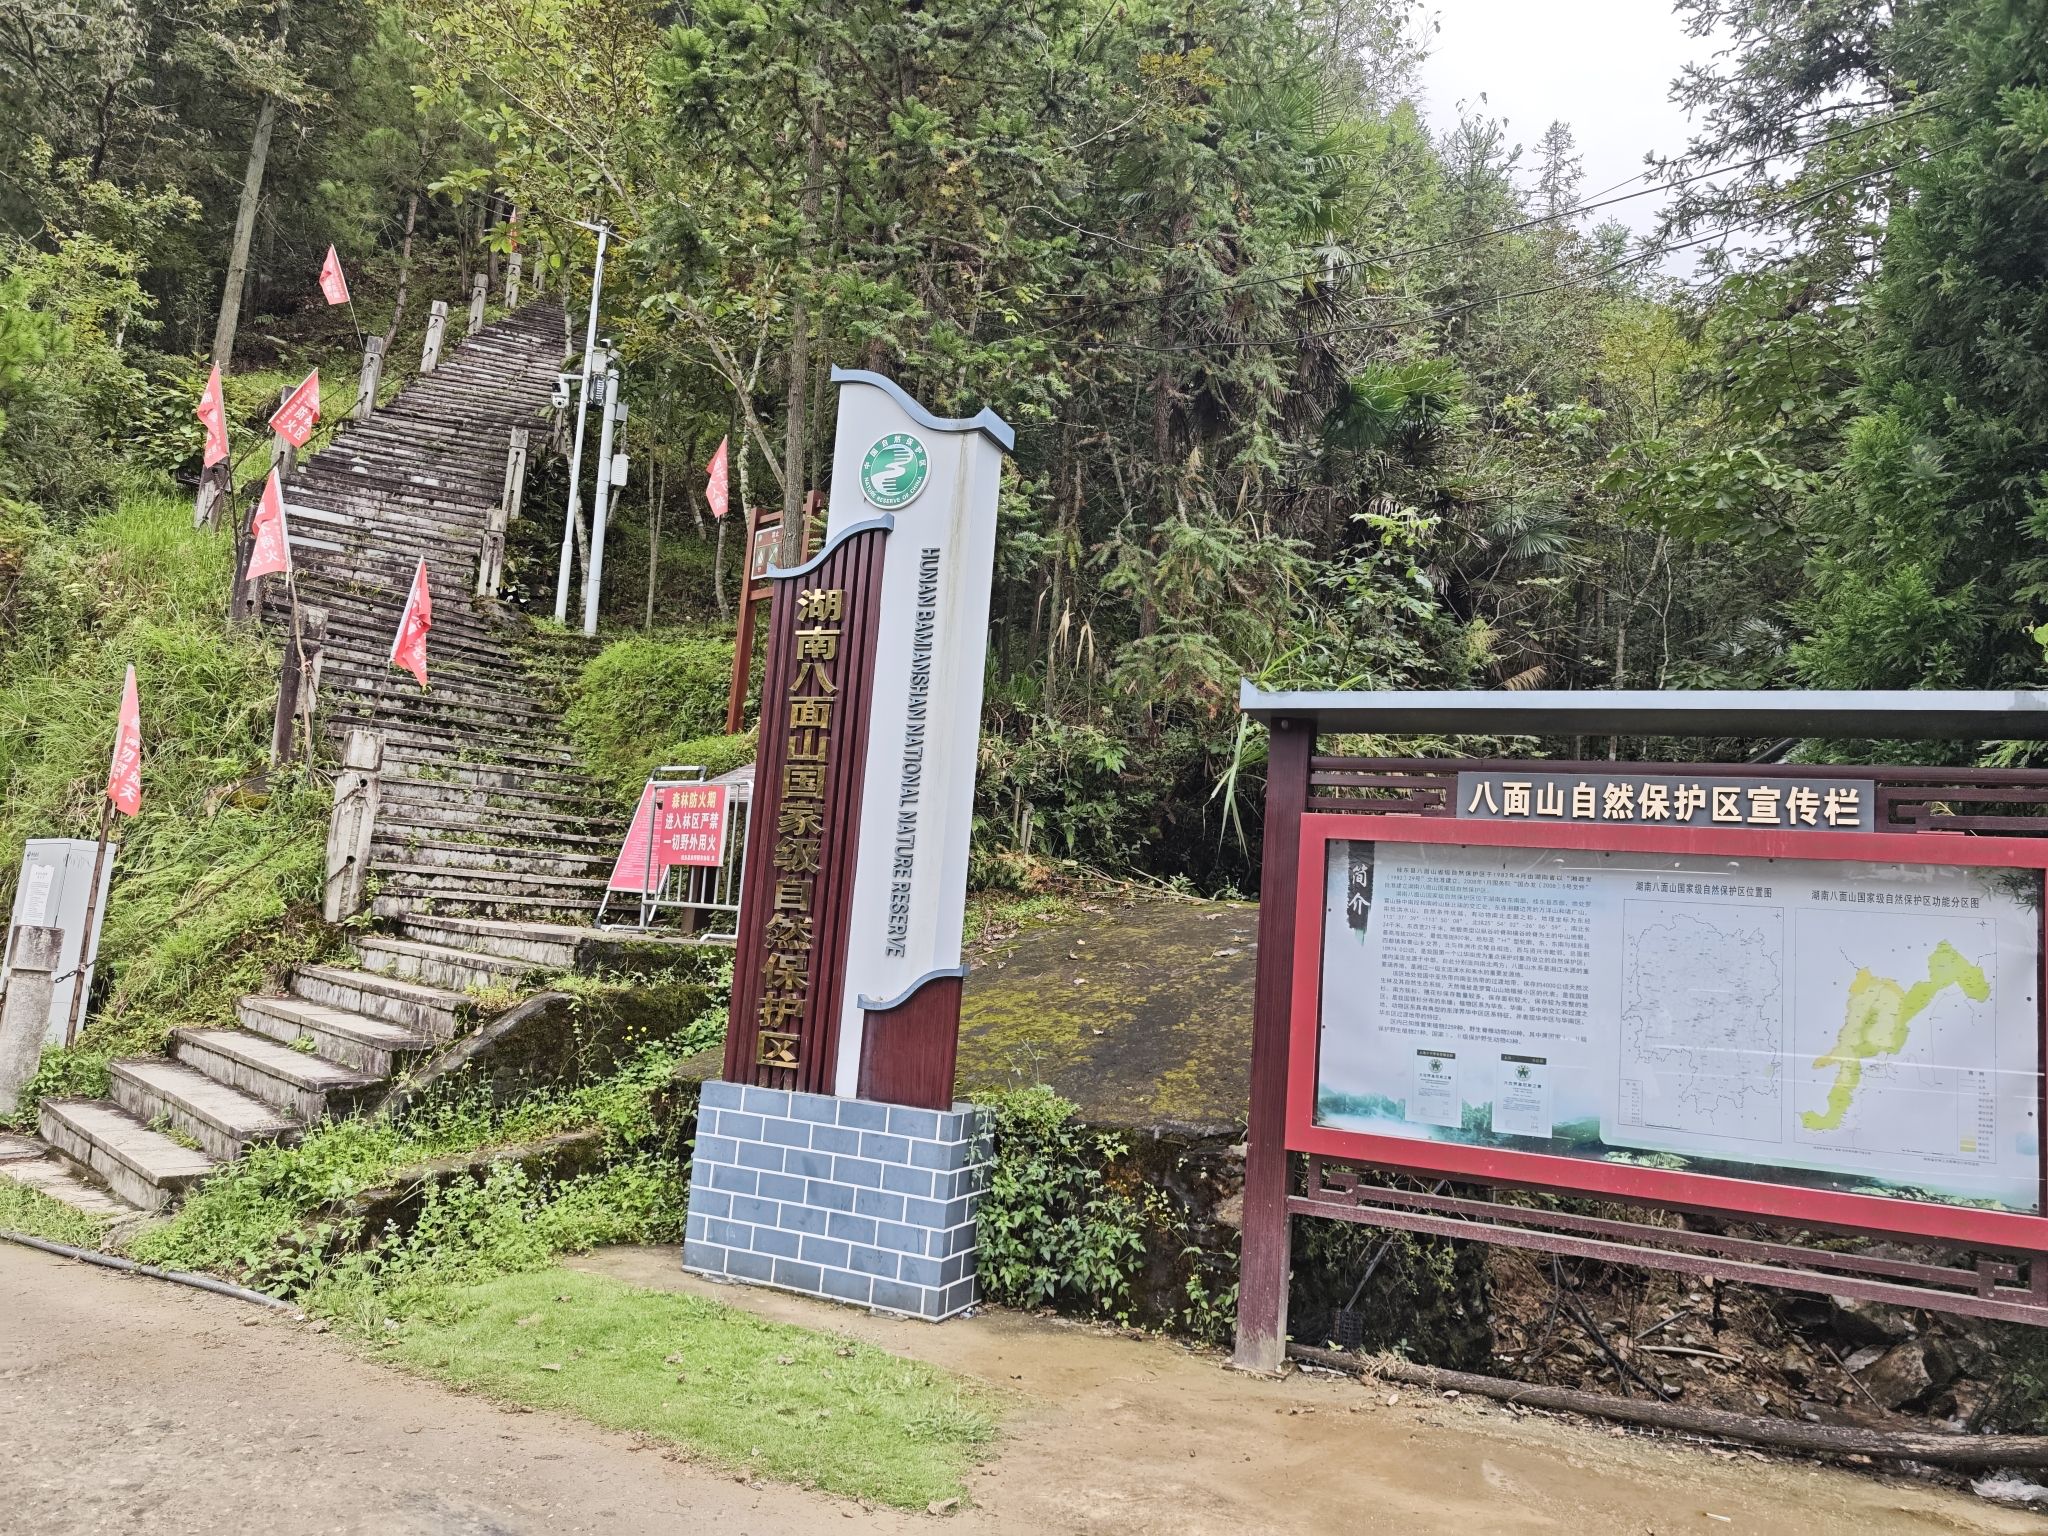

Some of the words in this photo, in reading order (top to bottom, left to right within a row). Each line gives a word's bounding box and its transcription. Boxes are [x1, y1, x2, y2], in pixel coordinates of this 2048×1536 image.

[864, 476, 877, 499] NATURE
[877, 495, 901, 504] RESERVE
[902, 492, 910, 500] OF
[910, 476, 923, 493] CHINA
[916, 547, 940, 607] HUNAN
[907, 610, 936, 720] BAMIANSHAN
[898, 723, 926, 807] NATIONAL
[665, 812, 719, 829] 进入林区严禁
[671, 791, 717, 809] 森林防火期
[1468, 780, 1861, 827] 八面山自然保护区宣传栏
[663, 833, 716, 851] 一切野外用火
[756, 588, 843, 1070] 湖南八面山国家级自然保护区
[892, 810, 918, 878] NATURE
[1348, 864, 1371, 915] 简介
[1635, 880, 1773, 899] 湖南八面山国家级自然保护区位置图
[1811, 889, 1980, 910] 湖南八面山国家级自然保护区功能分区图
[885, 881, 911, 958] RESERVE
